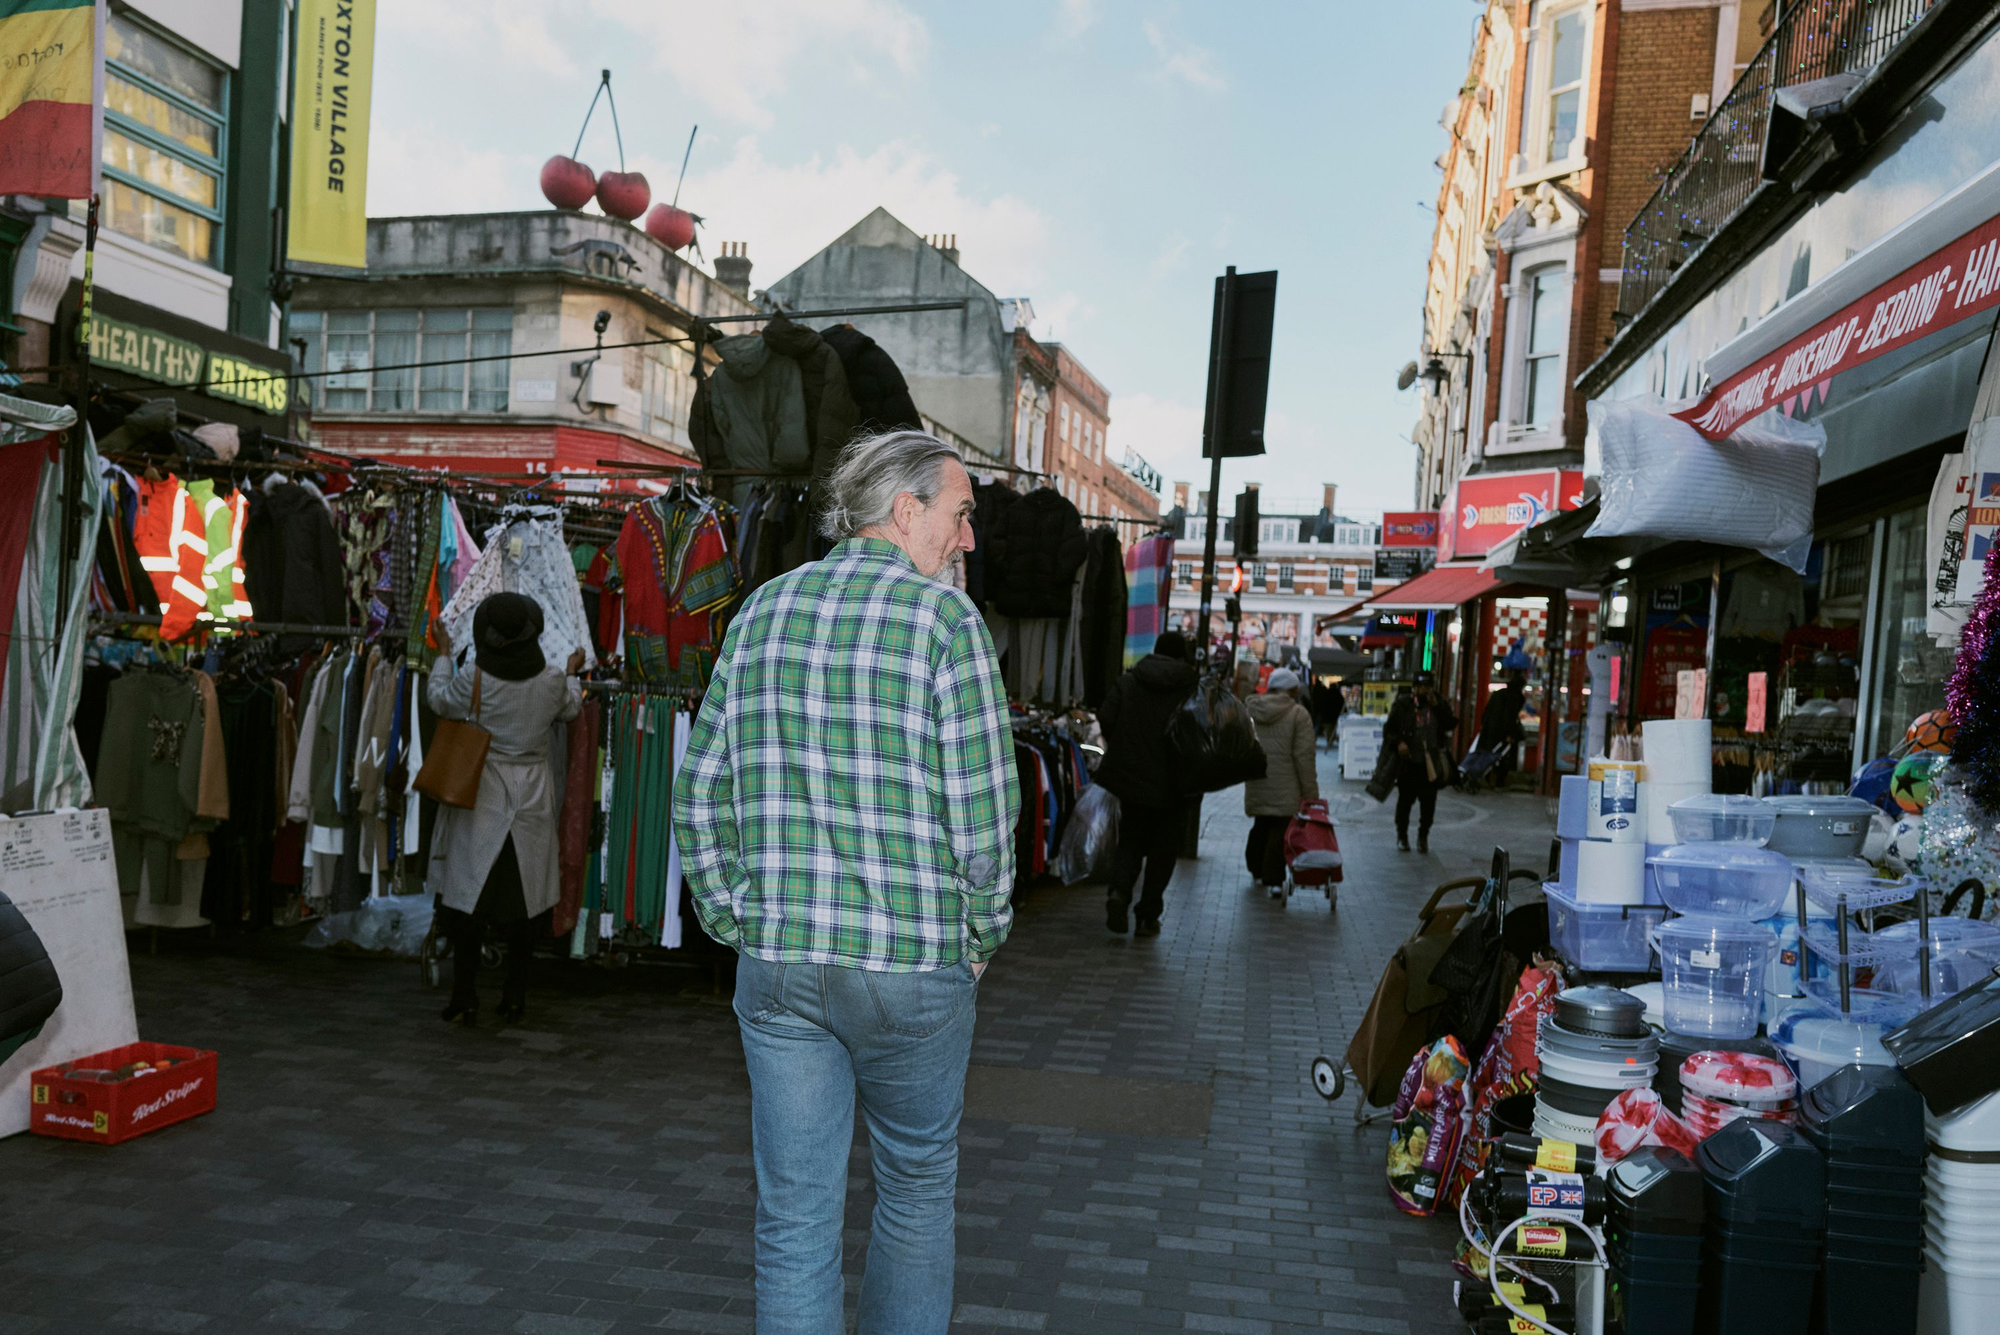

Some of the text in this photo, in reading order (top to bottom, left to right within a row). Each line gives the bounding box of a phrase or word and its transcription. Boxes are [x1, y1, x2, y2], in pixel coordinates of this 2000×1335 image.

[327, 85, 349, 194] VILLAGE
[89, 319, 200, 383] HEALTHY
[210, 357, 287, 411] EATERS
[1772, 315, 1860, 399] HOUSEHOLD
[1857, 265, 1952, 353] BEDDING
[1506, 502, 1529, 524] FISH
[131, 1077, 204, 1126] Red Stripe
[1530, 1186, 1558, 1206] EP
